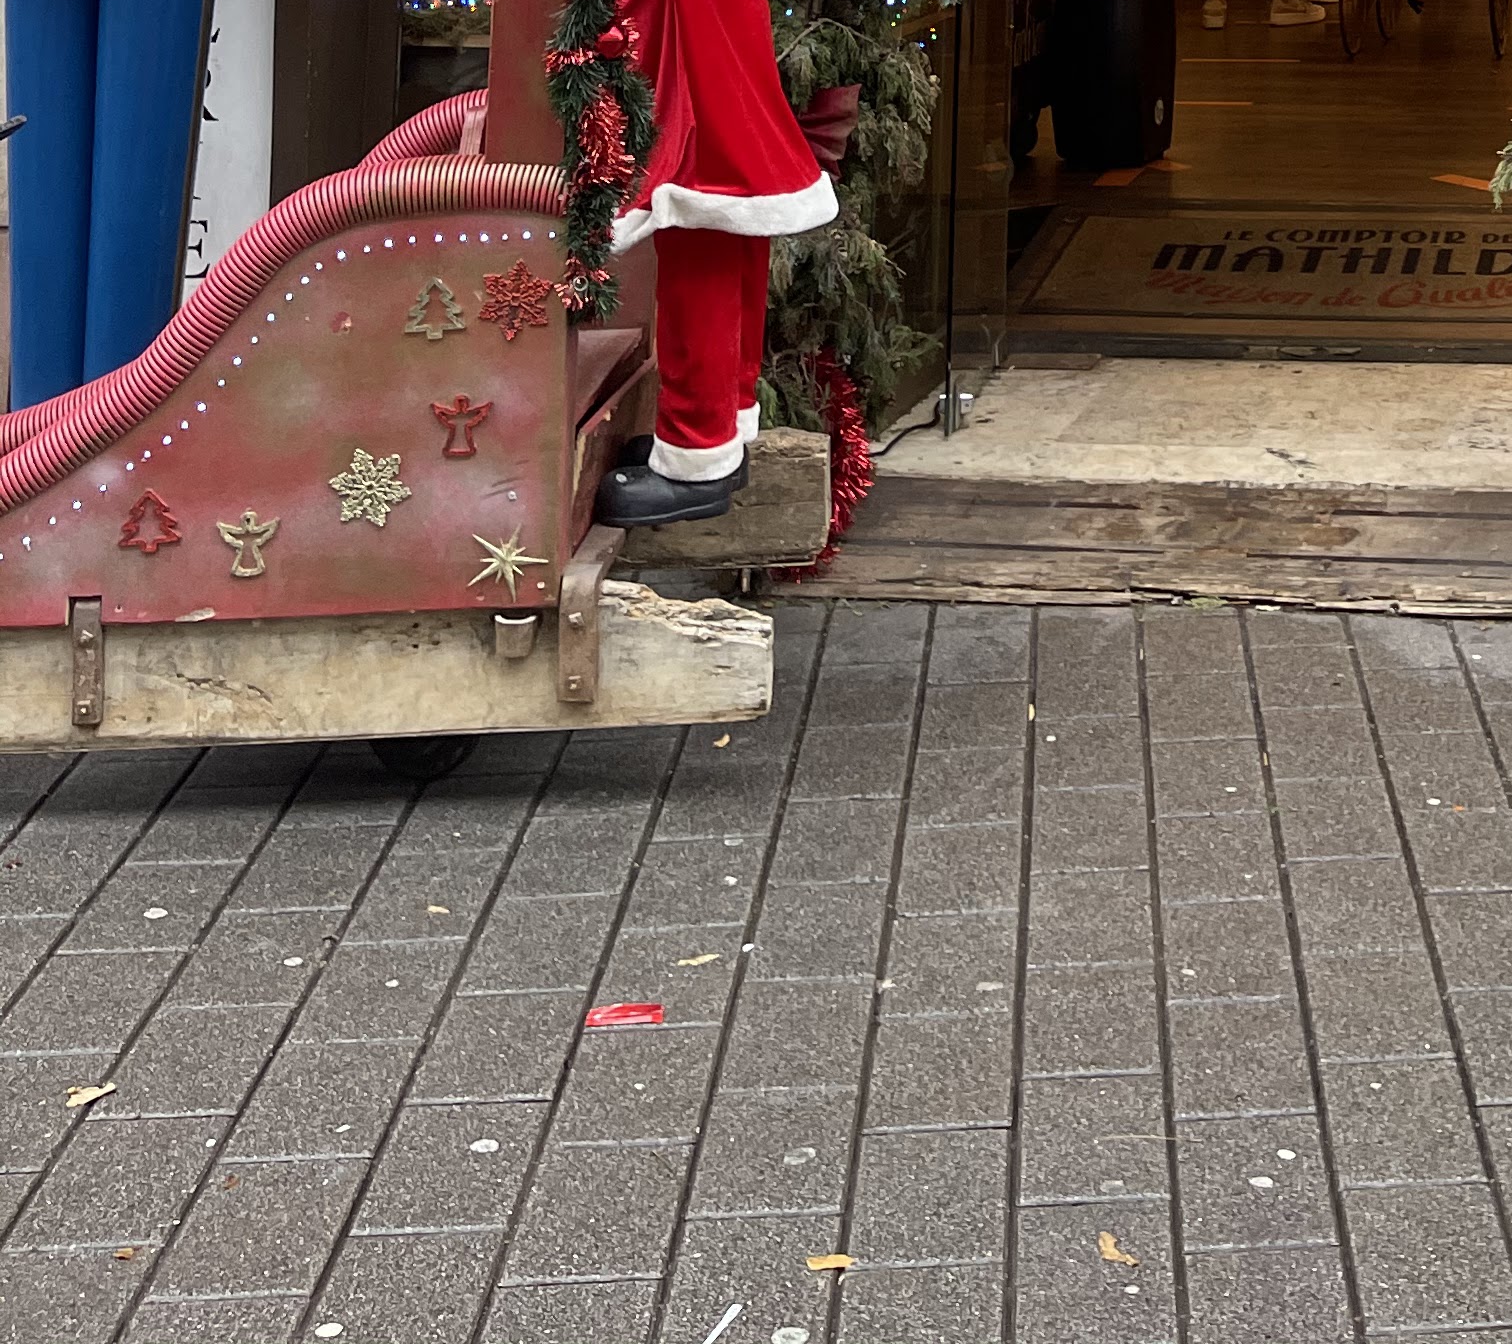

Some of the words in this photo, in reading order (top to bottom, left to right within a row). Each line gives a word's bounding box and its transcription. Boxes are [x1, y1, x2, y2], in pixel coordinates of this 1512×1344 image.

[1223, 230, 1252, 241] LE
[1266, 229, 1467, 243] COMPTOIR
[1320, 287, 1366, 307] de
